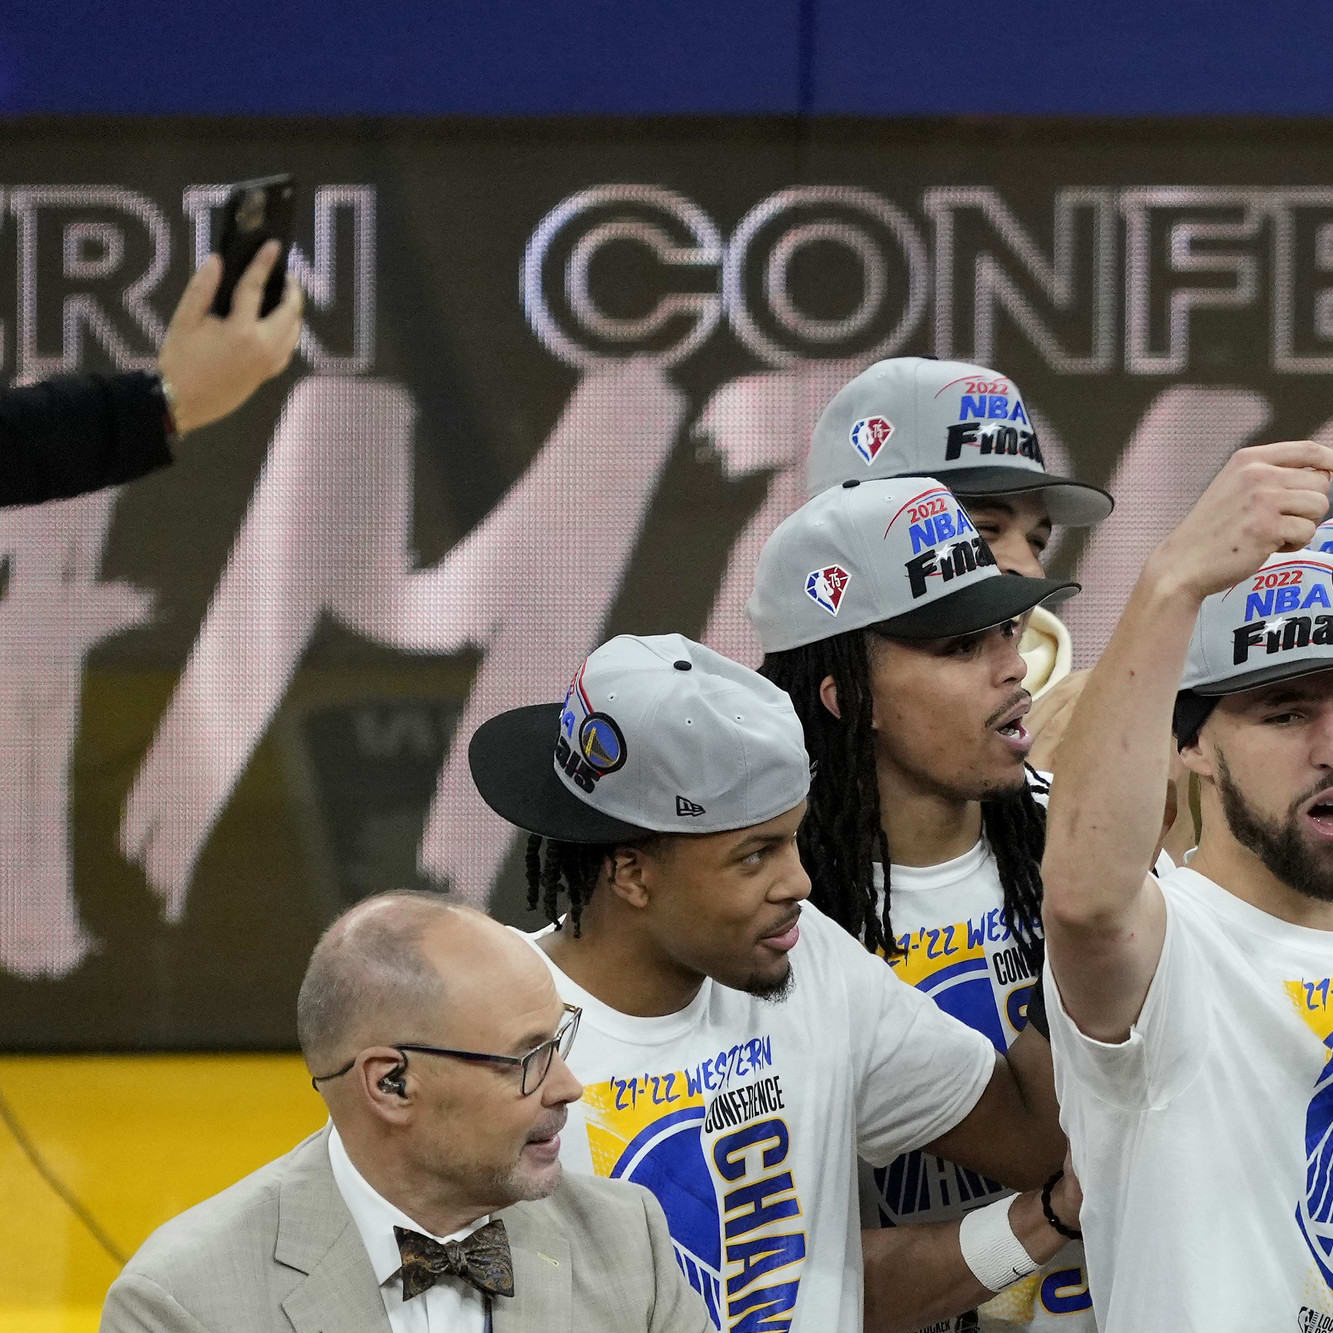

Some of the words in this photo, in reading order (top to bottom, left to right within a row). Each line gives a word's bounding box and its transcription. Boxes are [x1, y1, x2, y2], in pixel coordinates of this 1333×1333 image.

[0, 183, 378, 380] RN
[965, 382, 1008, 395] 2022
[959, 395, 1027, 425] NBA
[945, 422, 1044, 463] Fina
[907, 498, 948, 524] 2022
[908, 509, 973, 555] NBA
[905, 536, 998, 599] Fina
[1252, 570, 1303, 592] 2022
[1244, 584, 1331, 622] NBA
[685, 1034, 773, 1097] WESTERN
[705, 1075, 785, 1134] CONFERENCE
